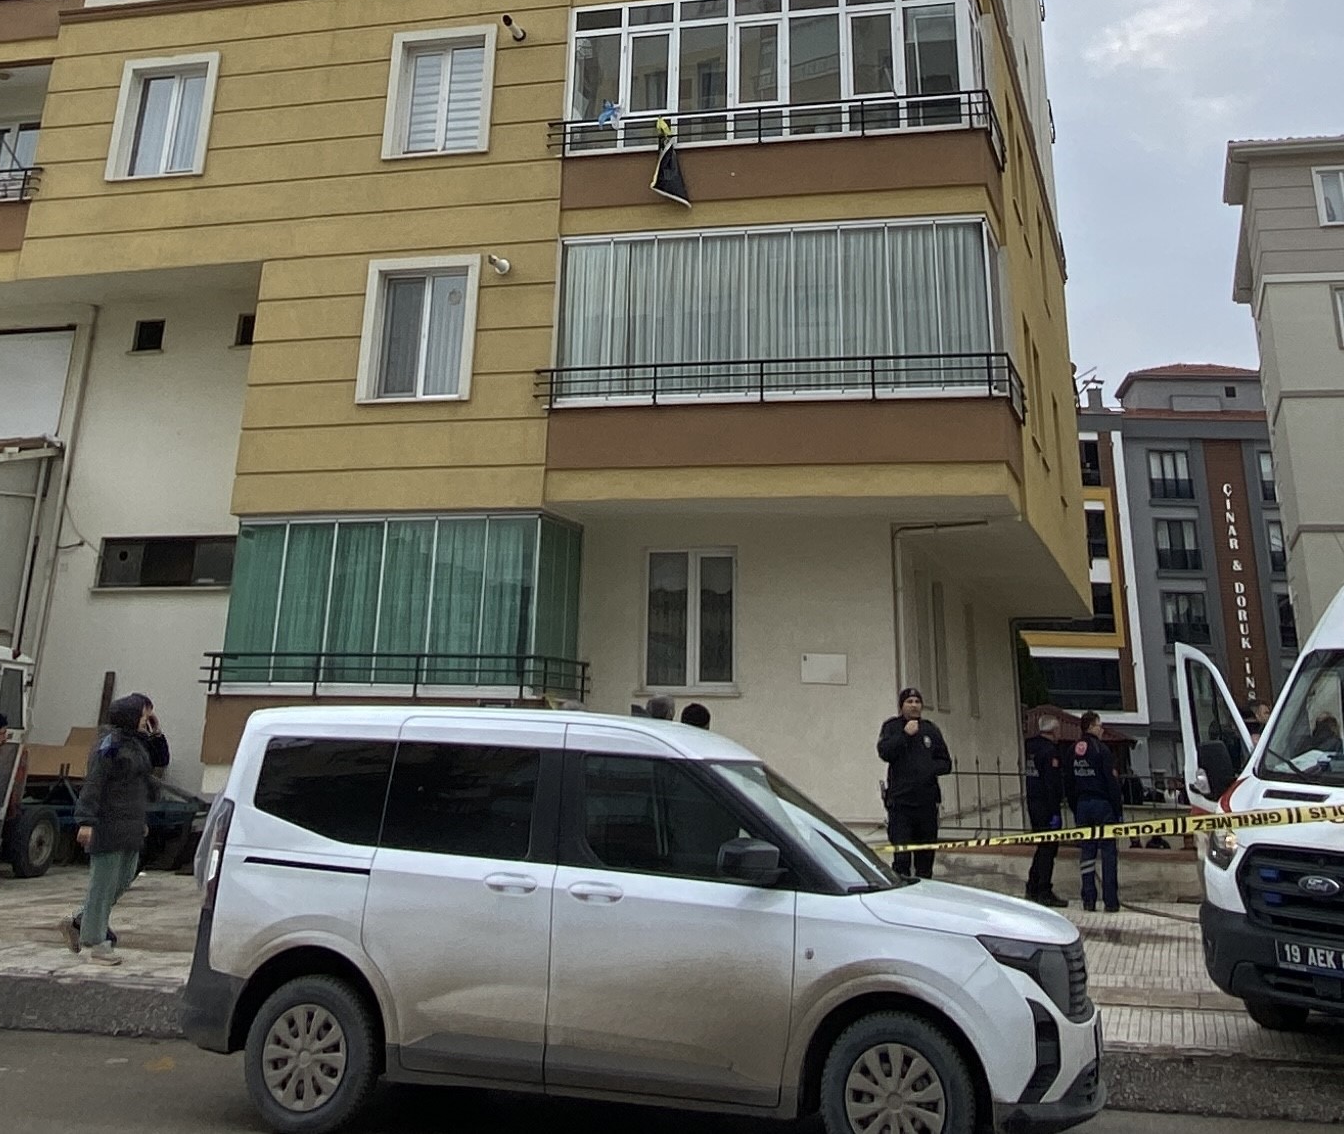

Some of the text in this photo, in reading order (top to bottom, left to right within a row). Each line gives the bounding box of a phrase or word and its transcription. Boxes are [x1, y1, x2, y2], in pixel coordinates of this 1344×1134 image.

[1234, 582, 1252, 649] DORUK
[1284, 944, 1301, 963] 19
[1308, 948, 1337, 969] AEK
